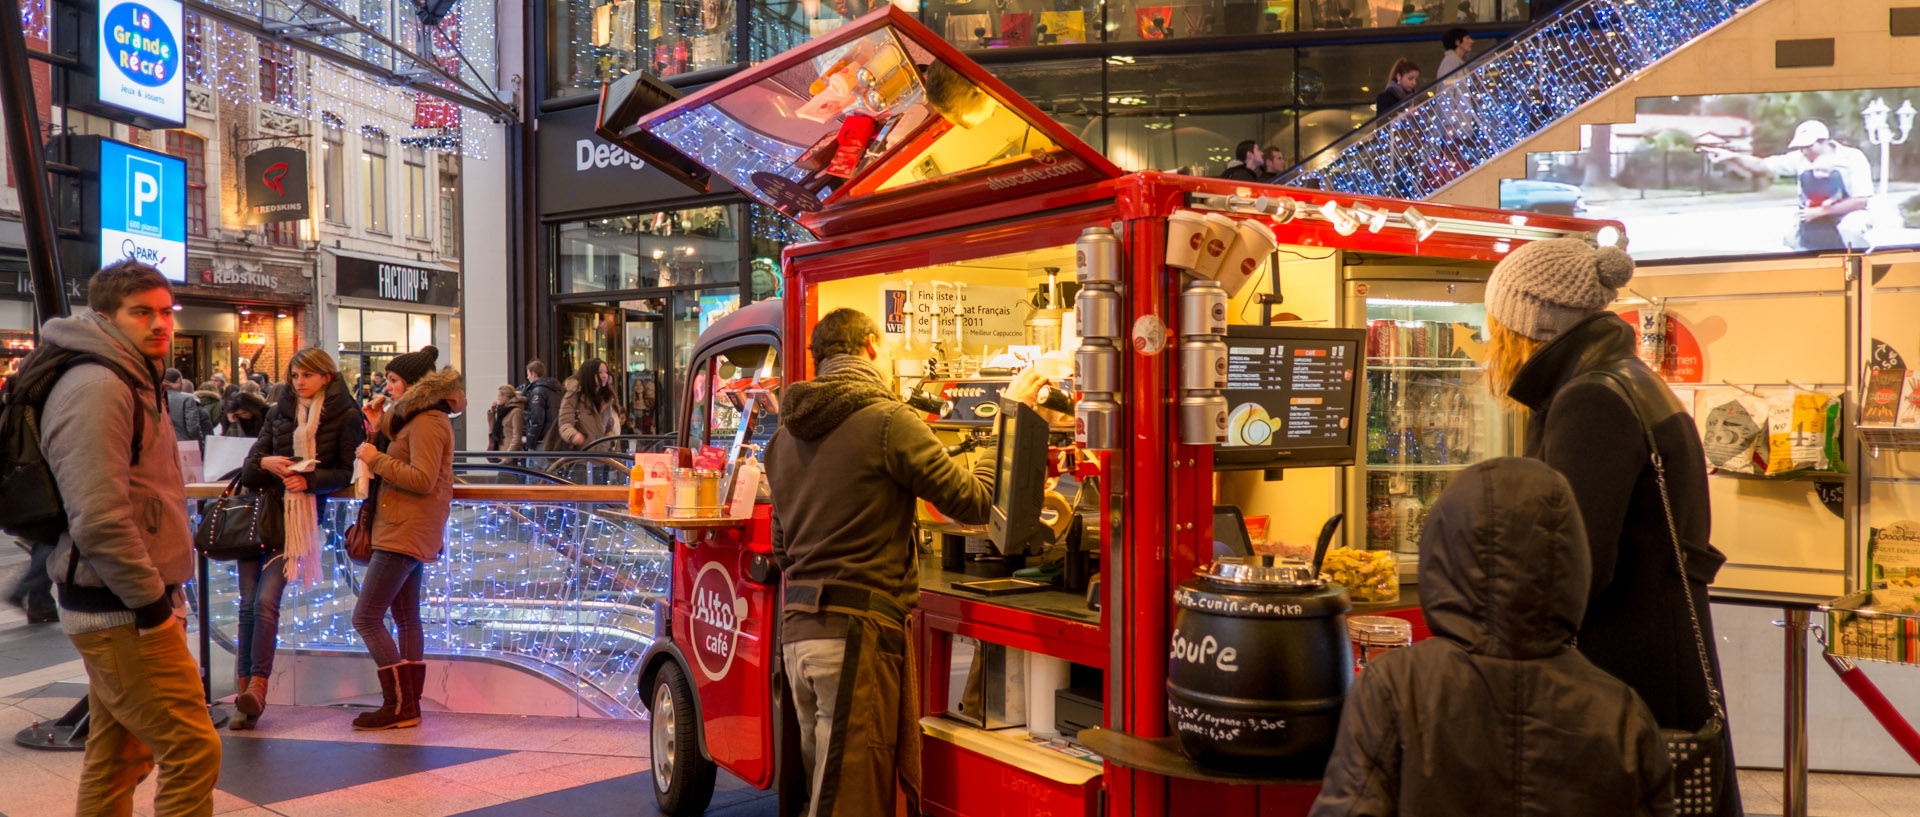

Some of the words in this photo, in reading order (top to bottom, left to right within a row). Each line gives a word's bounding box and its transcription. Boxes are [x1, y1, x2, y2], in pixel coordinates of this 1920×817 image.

[132, 8, 152, 31] La
[113, 25, 171, 61] Grande
[119, 50, 166, 81] Récré
[134, 171, 159, 217] P
[259, 203, 303, 214] REDSKINS
[213, 268, 279, 290] REDSKINS
[378, 263, 420, 302] FACTORY
[420, 270, 429, 291] 54
[918, 316, 929, 326] de
[977, 305, 1011, 316] Français
[695, 586, 734, 630] Alto
[706, 632, 728, 657] café
[1001, 766, 1052, 801] L'amour
